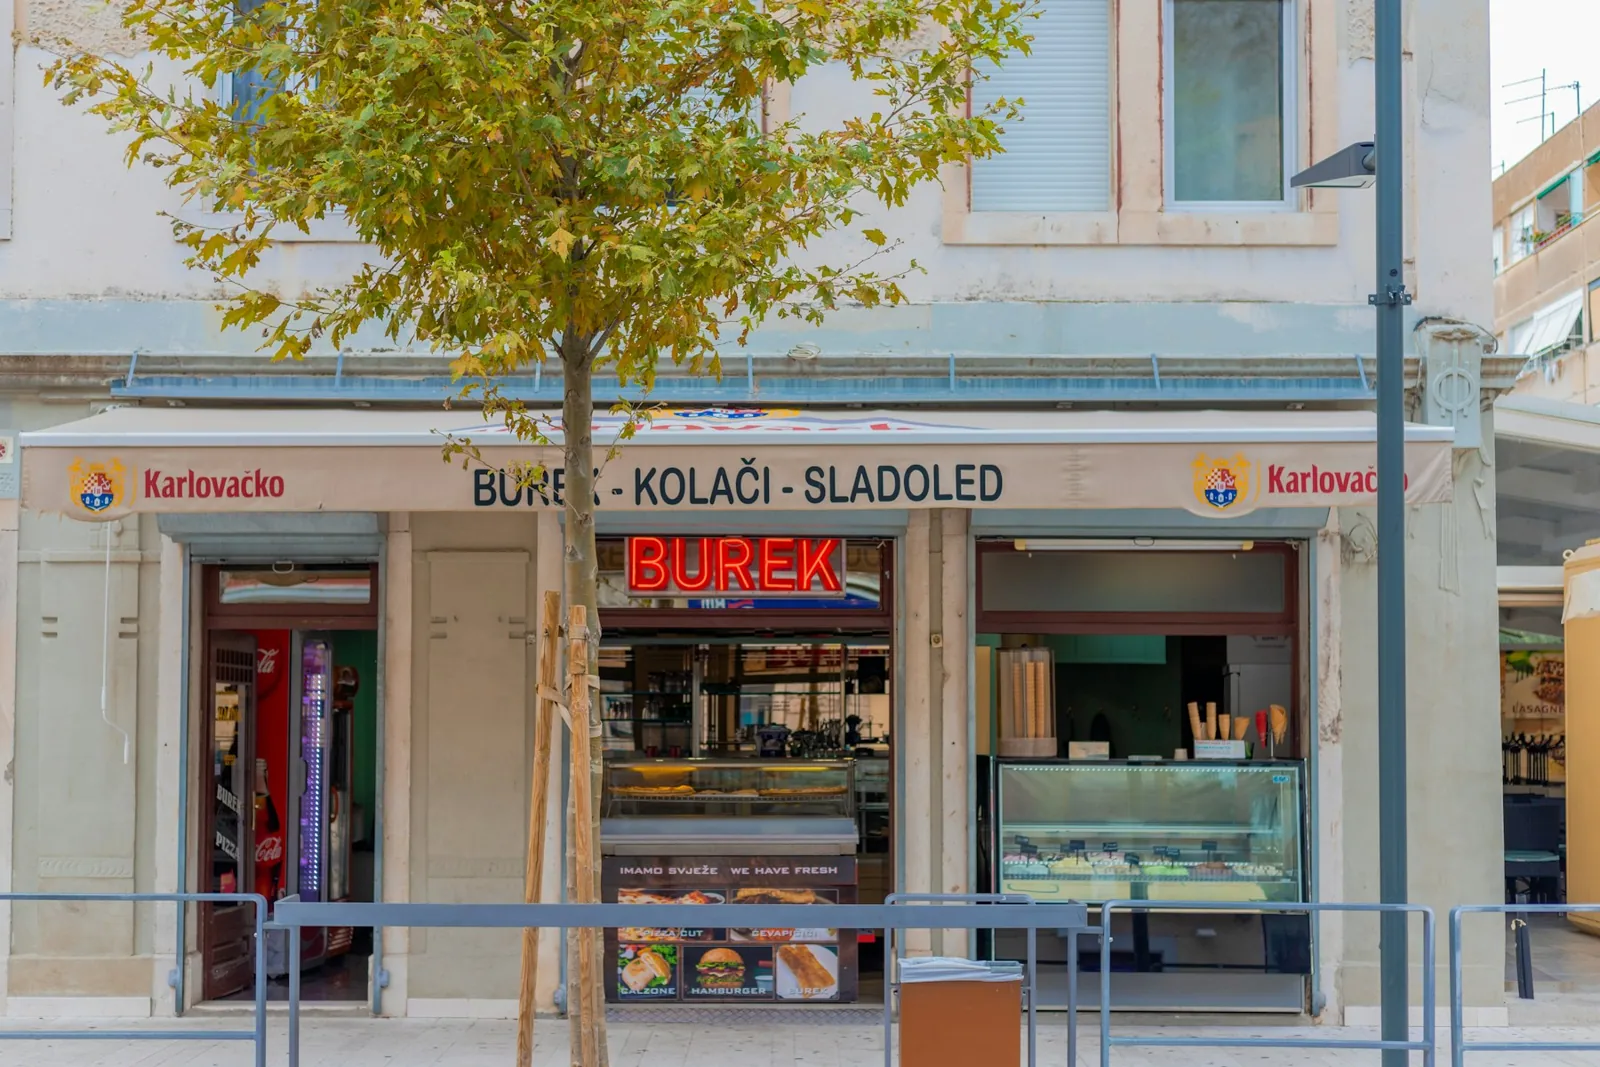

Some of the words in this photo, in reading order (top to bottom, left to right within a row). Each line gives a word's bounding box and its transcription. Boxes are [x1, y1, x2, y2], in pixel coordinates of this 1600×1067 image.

[144, 468, 285, 499] Karlovačko
[635, 457, 770, 505] KOLAČI
[804, 463, 1003, 504] SLADOLED
[1268, 463, 1408, 494] Karlovač
[628, 537, 841, 591] BUREK
[215, 830, 241, 862] PIZZA
[619, 866, 663, 876] IMAMO
[668, 863, 719, 876] SVJEŽE
[731, 866, 750, 876] WE
[755, 866, 790, 876] HAVE
[794, 866, 838, 876] FRESH
[642, 929, 676, 938] PIZZA
[680, 929, 704, 938] CUT
[620, 986, 676, 995] CALZONE
[690, 986, 767, 996] HAMBURGER
